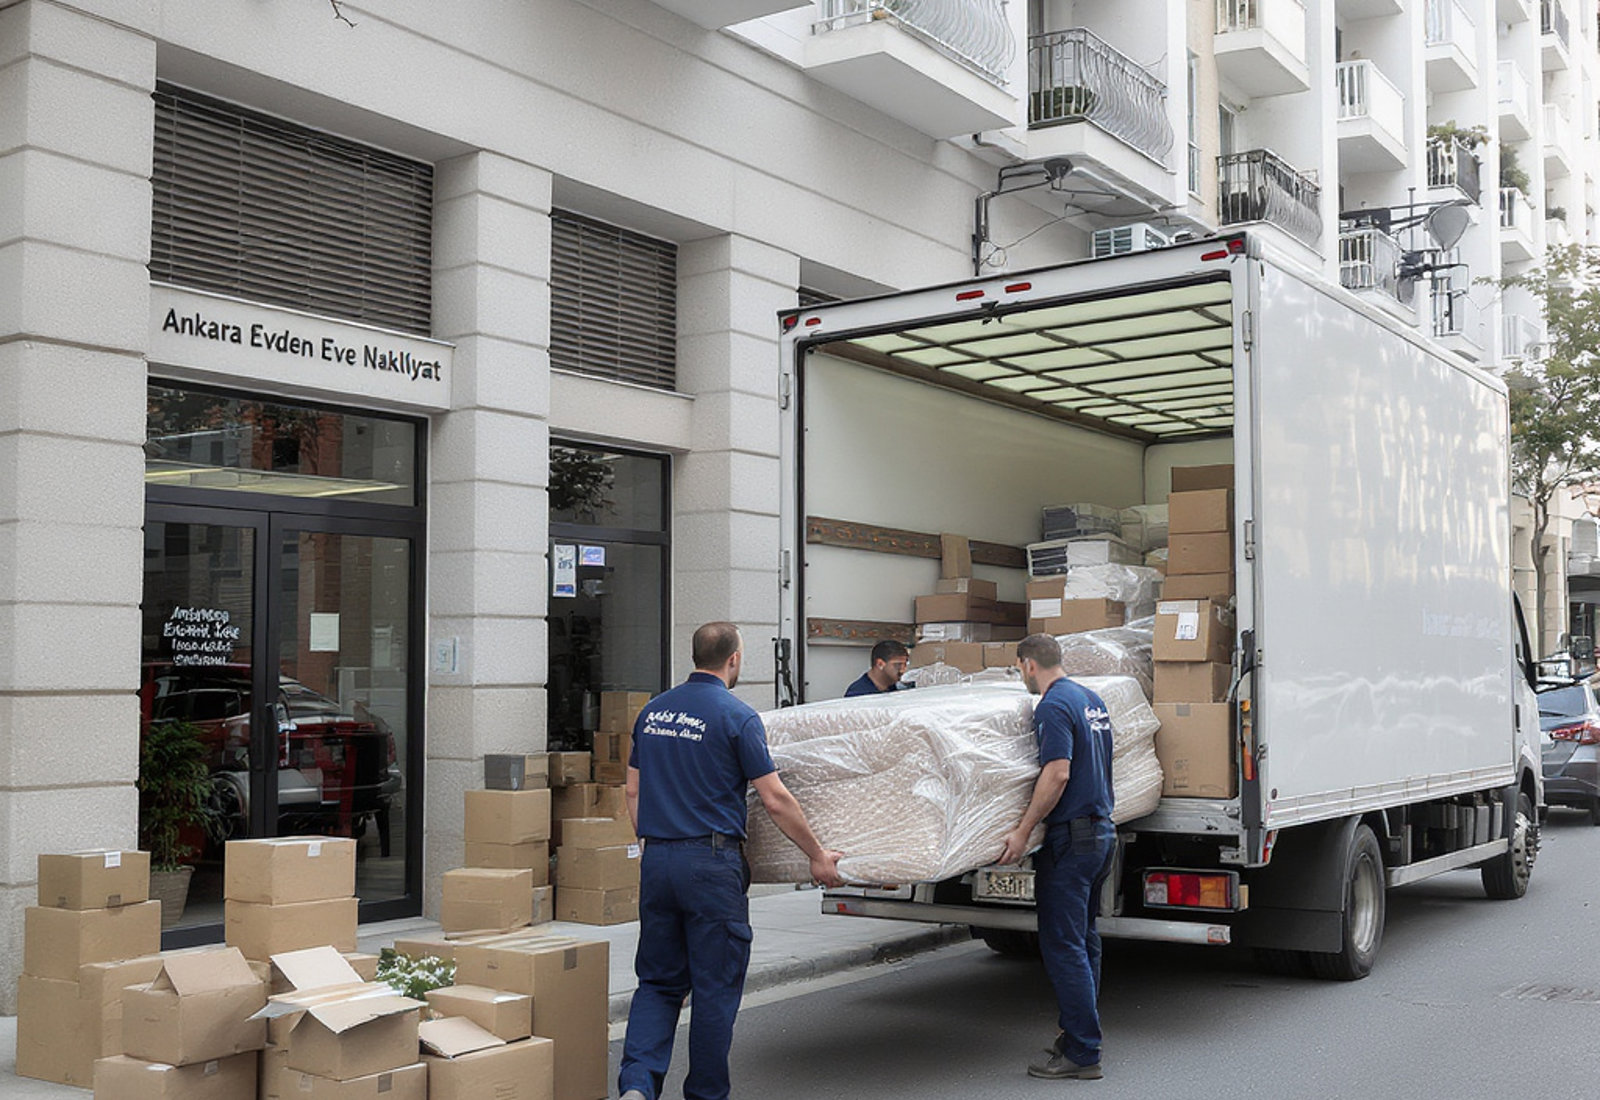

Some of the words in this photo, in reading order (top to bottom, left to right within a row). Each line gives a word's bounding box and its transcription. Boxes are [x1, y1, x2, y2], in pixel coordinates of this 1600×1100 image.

[163, 308, 242, 344] Ankara
[250, 324, 313, 358] Evden
[321, 338, 356, 366] Eve
